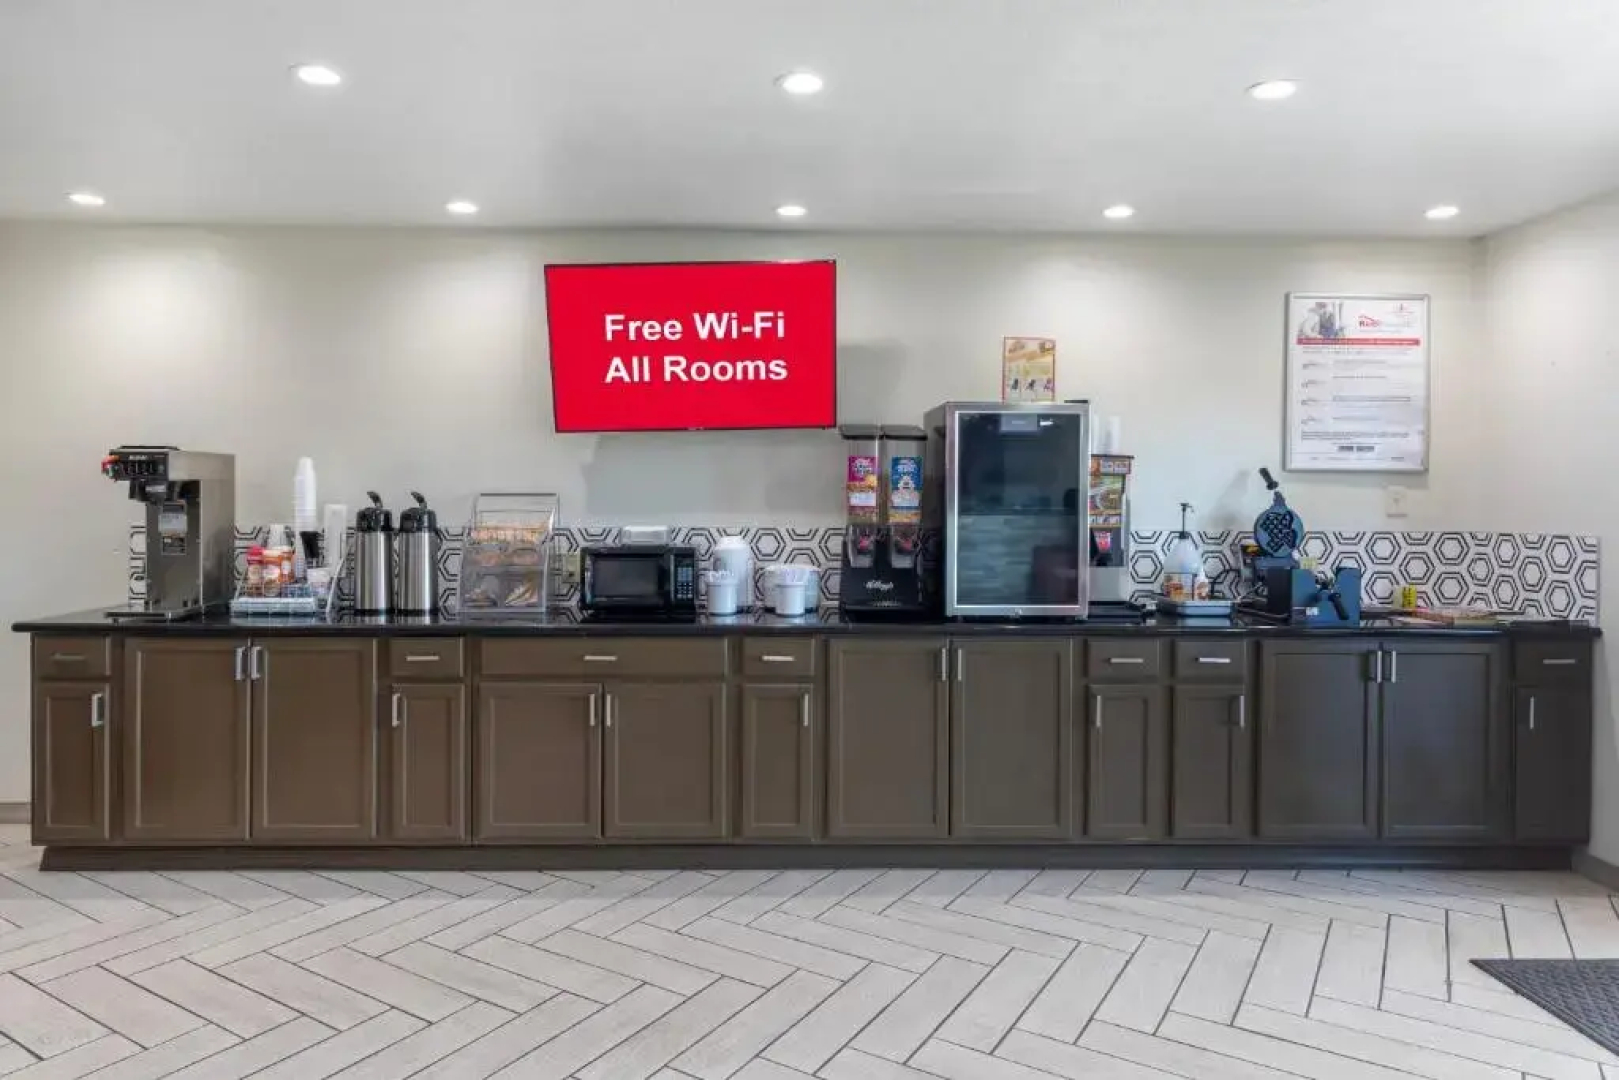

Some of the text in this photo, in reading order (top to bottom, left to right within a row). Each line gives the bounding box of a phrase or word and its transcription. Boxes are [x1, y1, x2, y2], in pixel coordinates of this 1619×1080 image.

[605, 311, 785, 341] Free Wi-Fi
[605, 355, 788, 383] All Rooms
